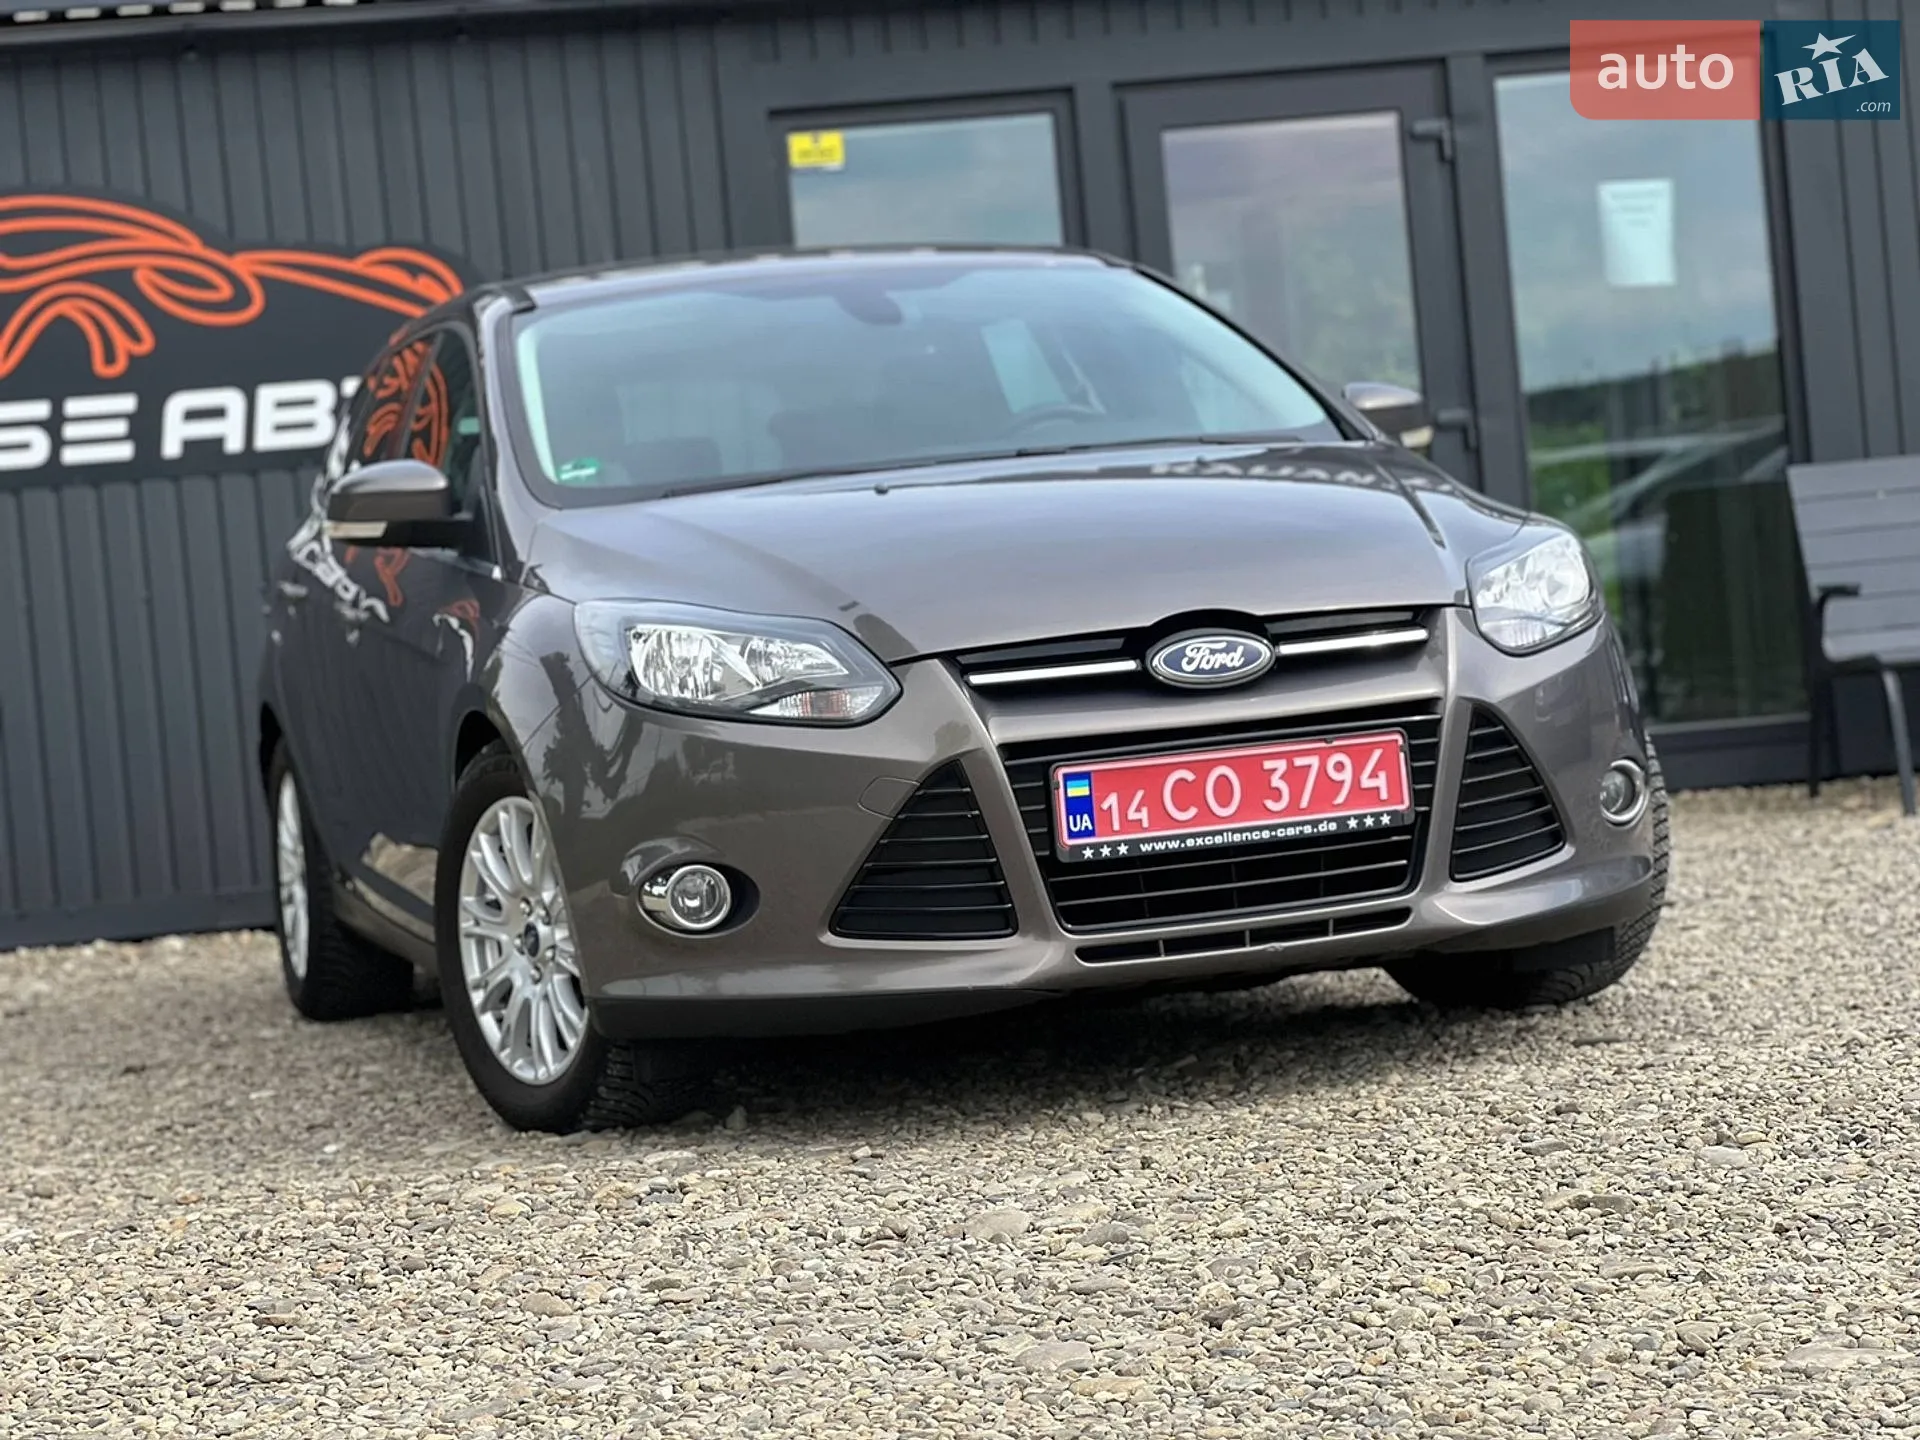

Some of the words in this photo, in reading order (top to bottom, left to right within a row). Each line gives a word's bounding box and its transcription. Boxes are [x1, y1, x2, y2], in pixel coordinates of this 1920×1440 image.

[1181, 641, 1245, 672] Ford
[1100, 789, 1150, 832] 14
[1162, 764, 1242, 822] CO
[1261, 748, 1389, 813] 3794
[1069, 813, 1093, 833] UA
[1139, 820, 1338, 853] www.excellence-cars.de
